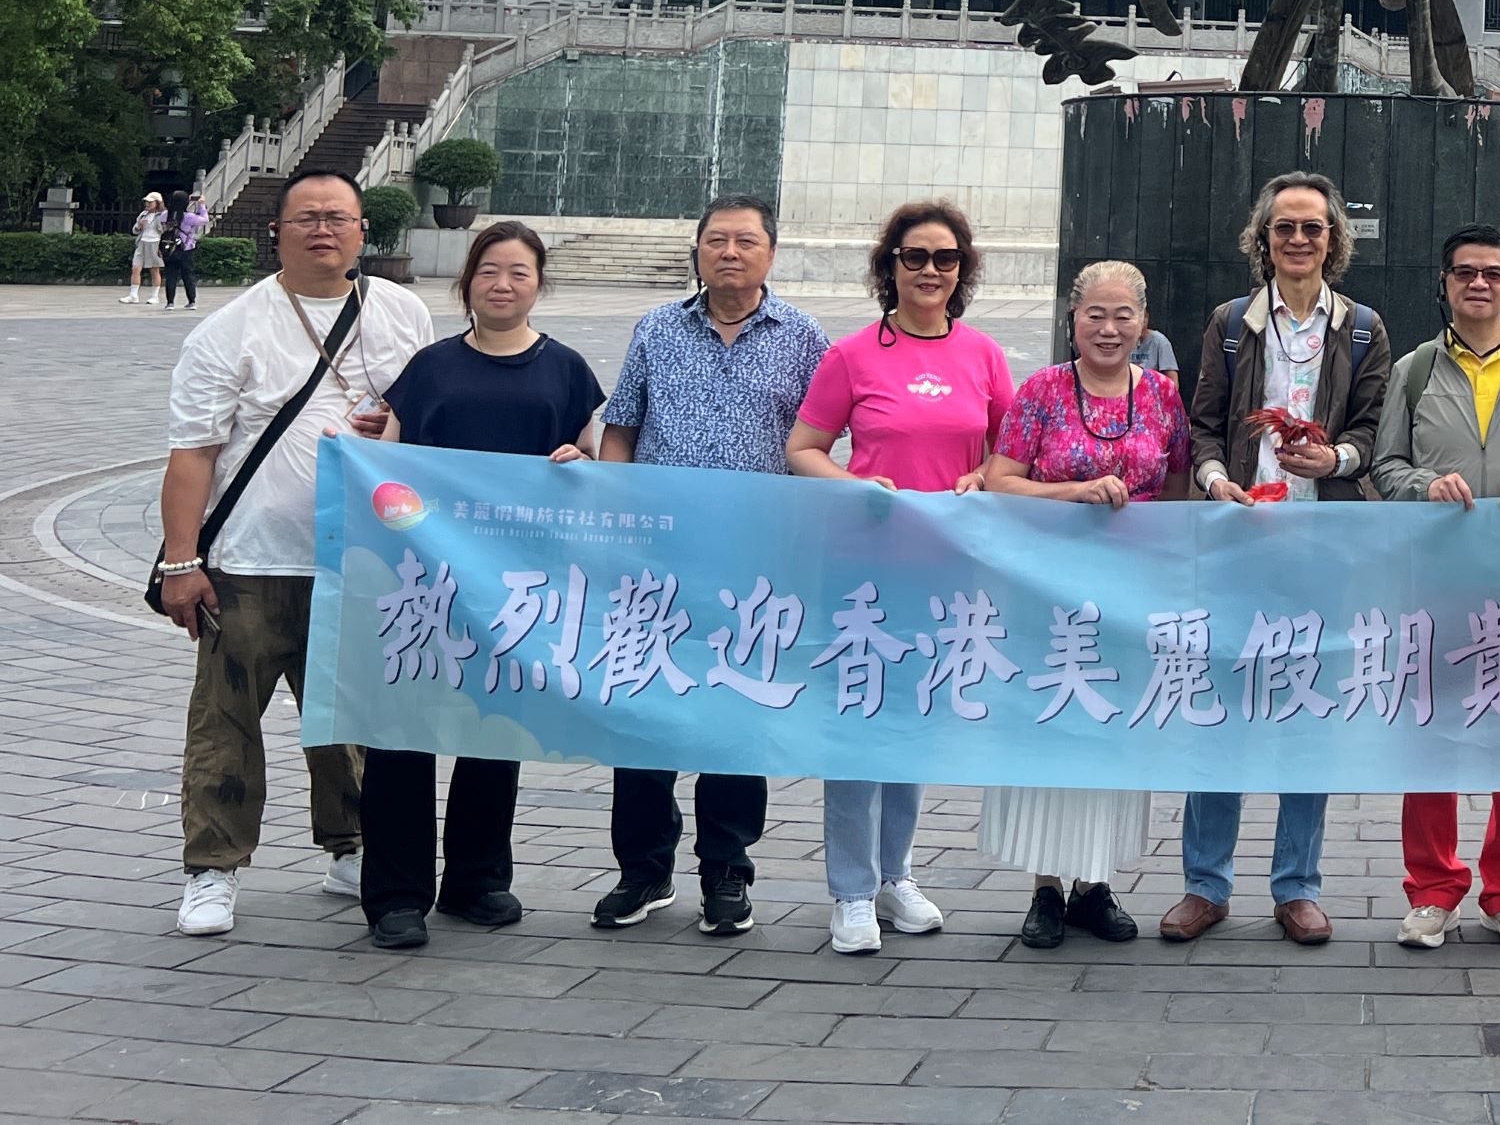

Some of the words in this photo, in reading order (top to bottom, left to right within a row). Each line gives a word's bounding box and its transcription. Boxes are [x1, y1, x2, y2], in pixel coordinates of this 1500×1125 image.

[453, 500, 675, 532] 美麗假期旅行社有限公司
